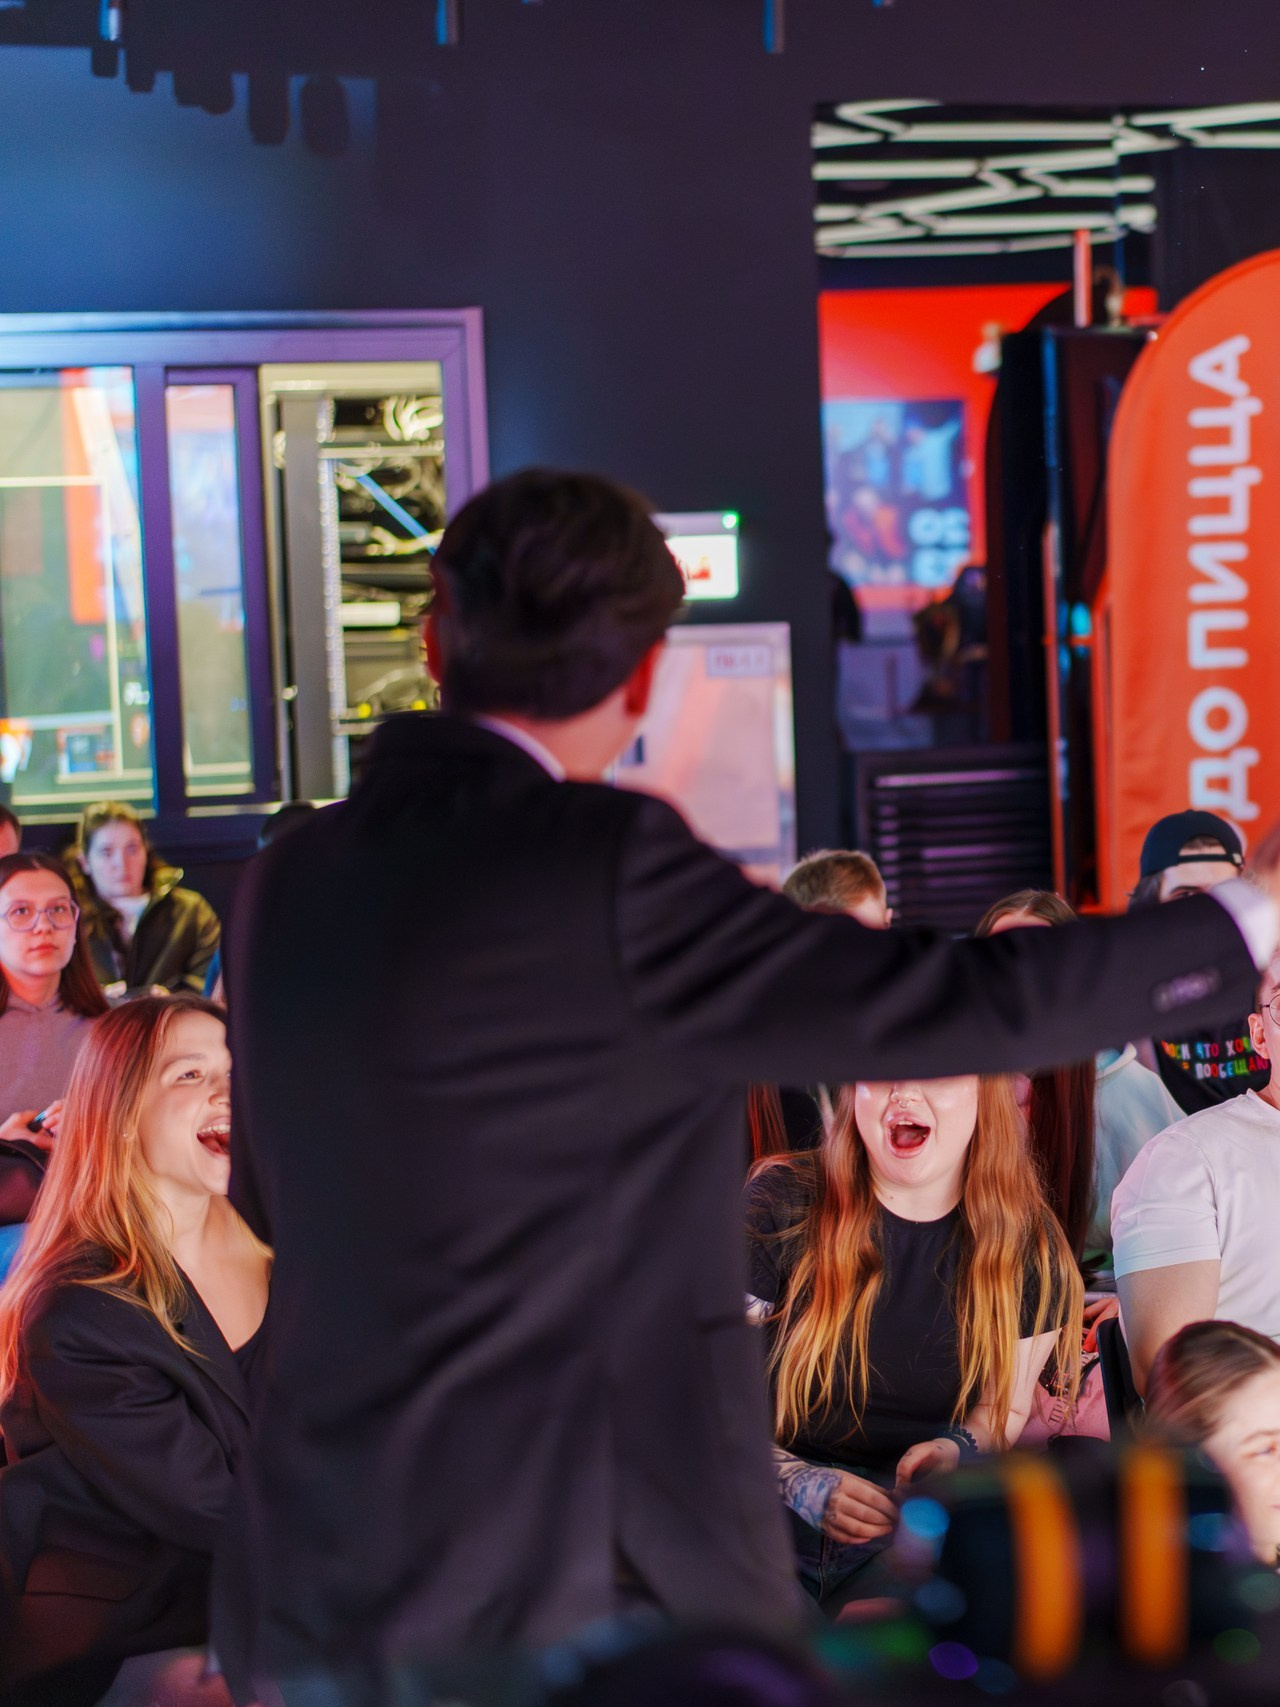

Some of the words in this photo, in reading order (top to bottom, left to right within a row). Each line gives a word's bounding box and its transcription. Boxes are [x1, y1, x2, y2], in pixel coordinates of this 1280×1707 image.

[1187, 334, 1263, 670] ПИЦЦА
[1187, 686, 1260, 858] ДО
[1195, 1041, 1219, 1058] ЧТО
[1225, 1036, 1254, 1057] ХОЧ
